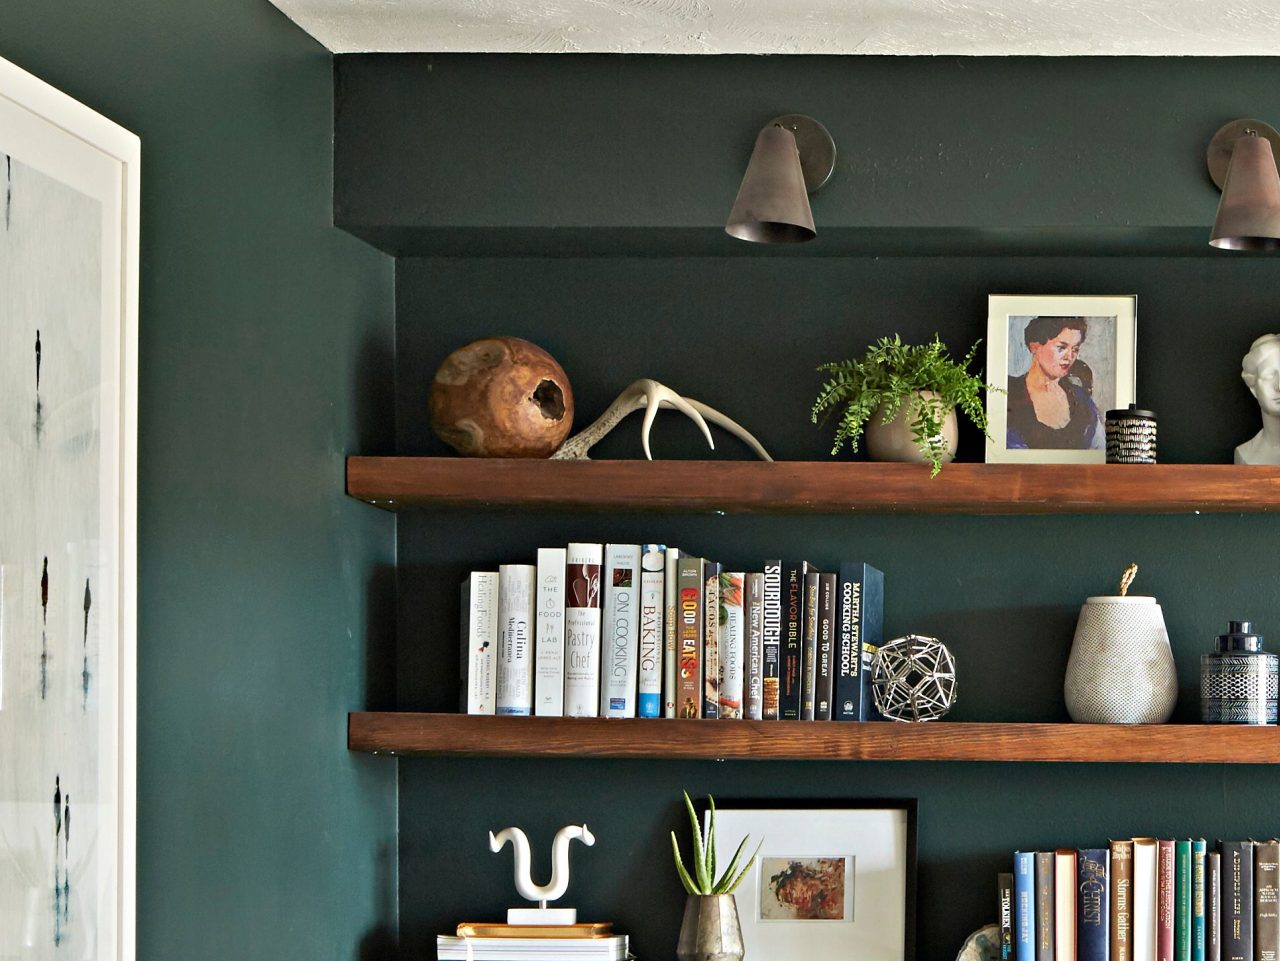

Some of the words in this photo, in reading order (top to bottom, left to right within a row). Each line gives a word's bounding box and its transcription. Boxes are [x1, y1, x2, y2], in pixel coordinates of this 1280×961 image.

[617, 592, 629, 613] ON
[681, 588, 700, 624] GOOD
[752, 606, 760, 627] New
[764, 565, 780, 645] SOURDOUGH
[789, 583, 798, 621] FLAVOR
[842, 582, 851, 632] COOKING
[851, 582, 860, 623] MARTHA
[517, 620, 526, 659] Culina
[568, 629, 595, 650] Pastry
[614, 618, 628, 677] COOKING
[641, 606, 656, 671] BAKING
[751, 629, 760, 674] American
[788, 622, 797, 649] BIBLE
[822, 642, 829, 651] TO
[850, 624, 859, 677] STEWART'S
[570, 651, 590, 668] Chef
[728, 651, 736, 680] FOODS
[841, 633, 850, 677] SCHOOL
[751, 677, 760, 699] Chef
[1002, 897, 1010, 928] TOLKIEN
[1080, 880, 1104, 926] CHRIST
[1117, 879, 1129, 911] Storms
[1117, 912, 1130, 942] Gather
